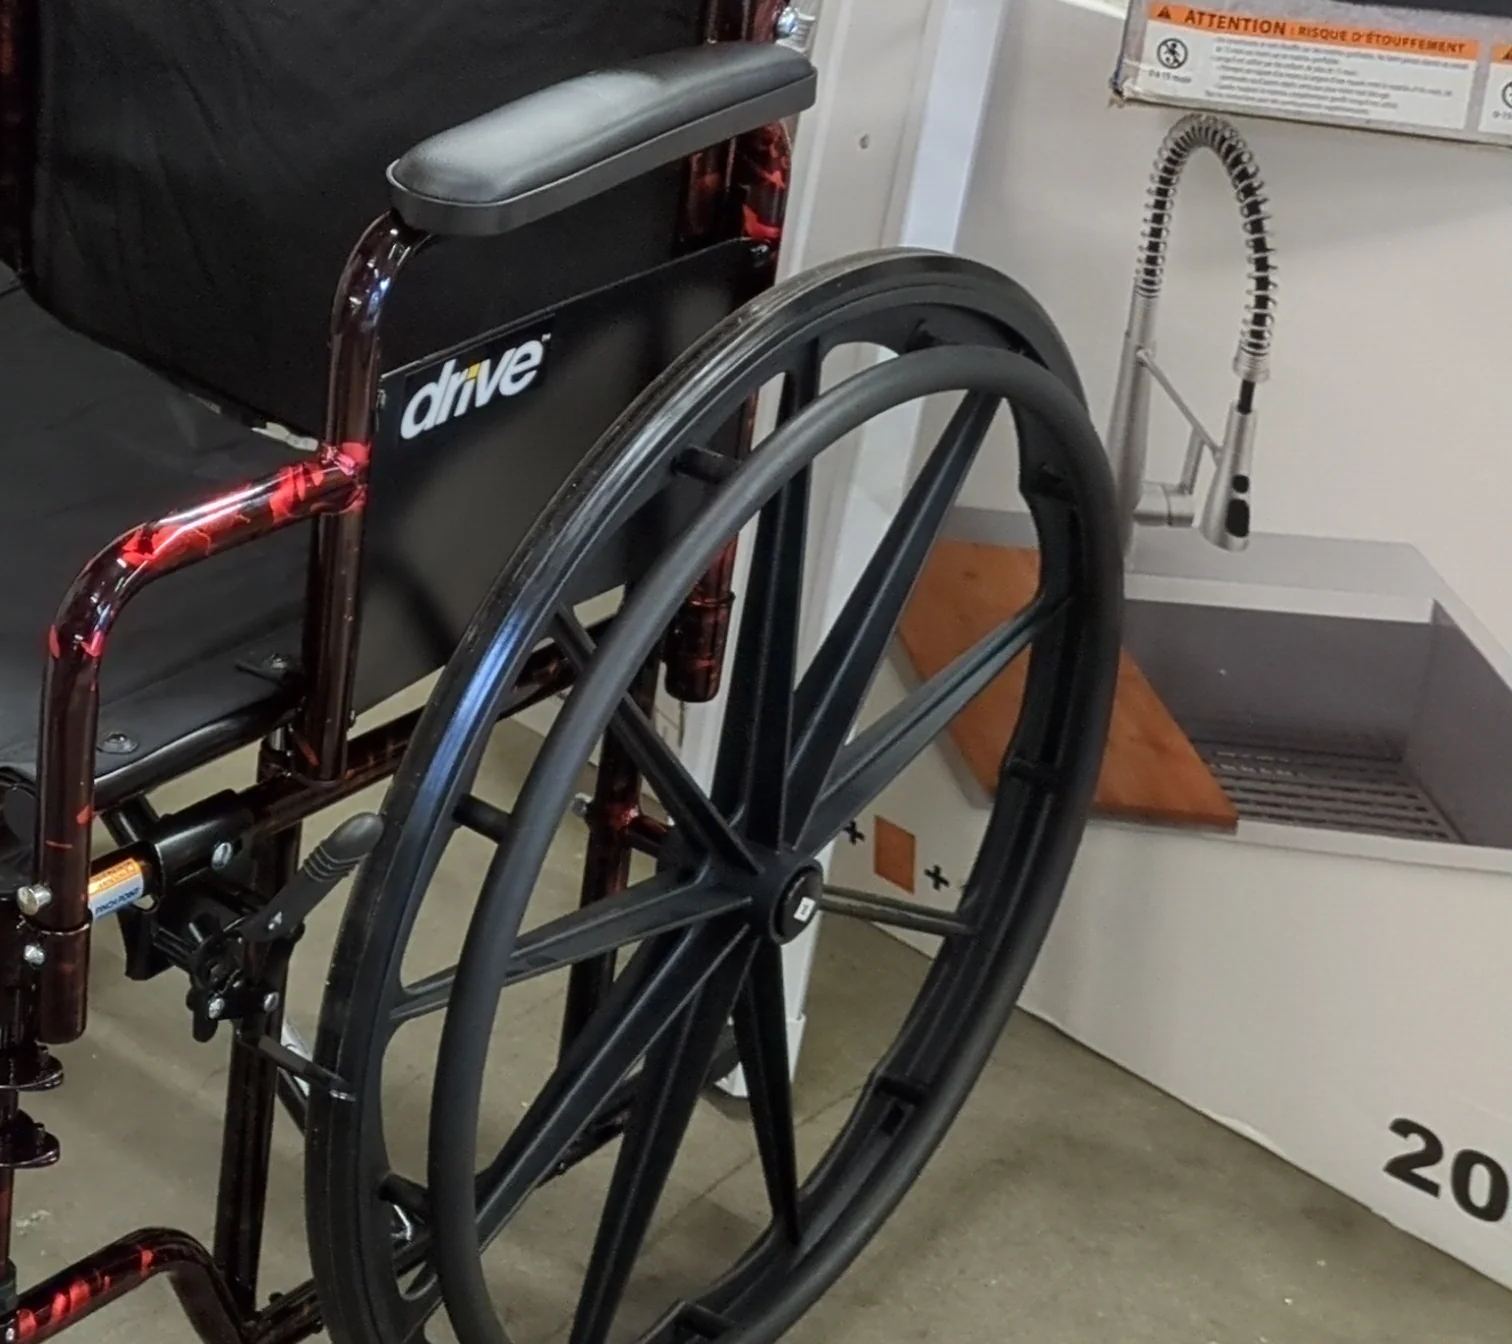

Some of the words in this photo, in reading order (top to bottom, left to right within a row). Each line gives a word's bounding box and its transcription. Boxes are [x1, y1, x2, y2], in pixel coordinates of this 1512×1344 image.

[1184, 9, 1287, 36] ATTENTION
[1298, 25, 1347, 42] RISQUE
[1351, 29, 1467, 54] D'ÉTOUFFEMENT
[399, 338, 546, 440] drive
[1383, 1117, 1509, 1223] 20
